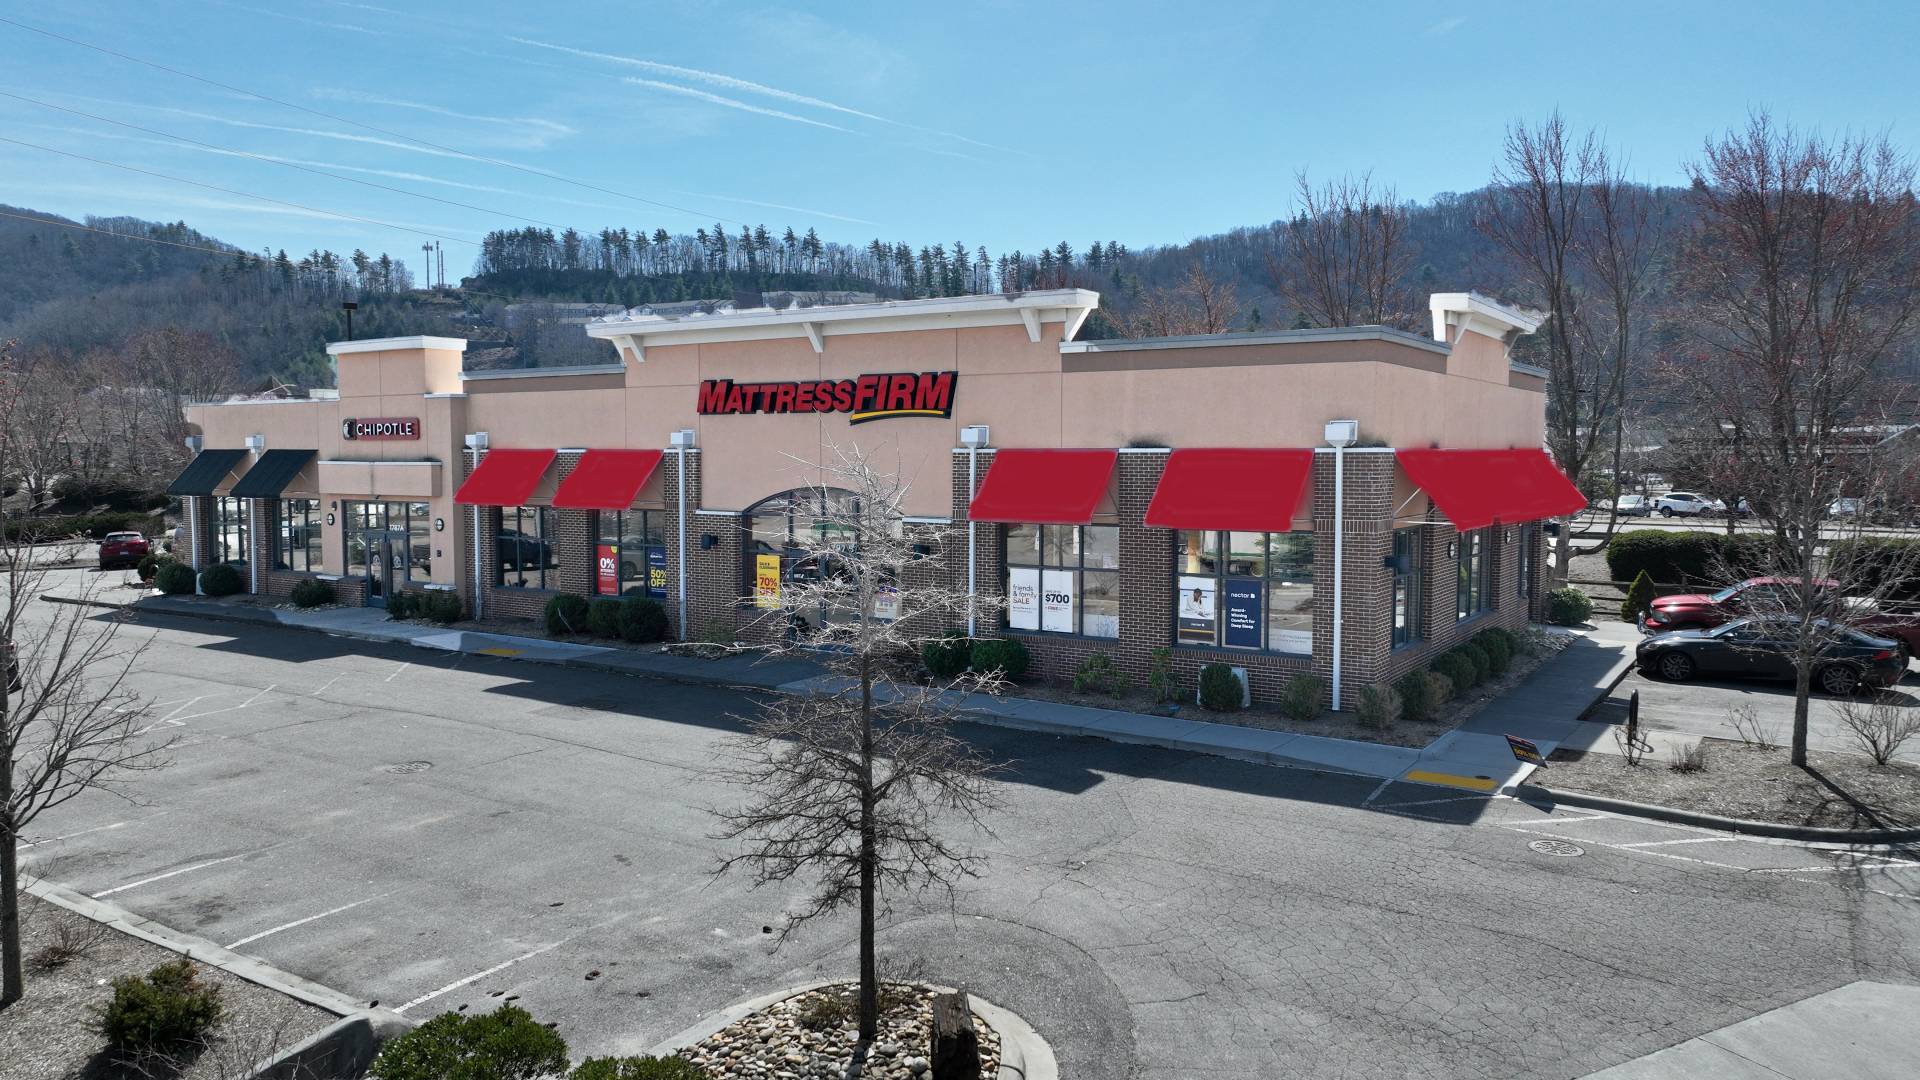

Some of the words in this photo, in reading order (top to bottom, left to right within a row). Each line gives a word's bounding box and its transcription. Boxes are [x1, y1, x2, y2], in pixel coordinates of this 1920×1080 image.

[356, 423, 412, 436] CHIPOTLE
[600, 558, 614, 568] 0%
[651, 570, 666, 578] 50%
[651, 579, 666, 587] OFF
[759, 576, 778, 587] 70%
[759, 587, 776, 596] OFF
[1045, 594, 1069, 603] $700
